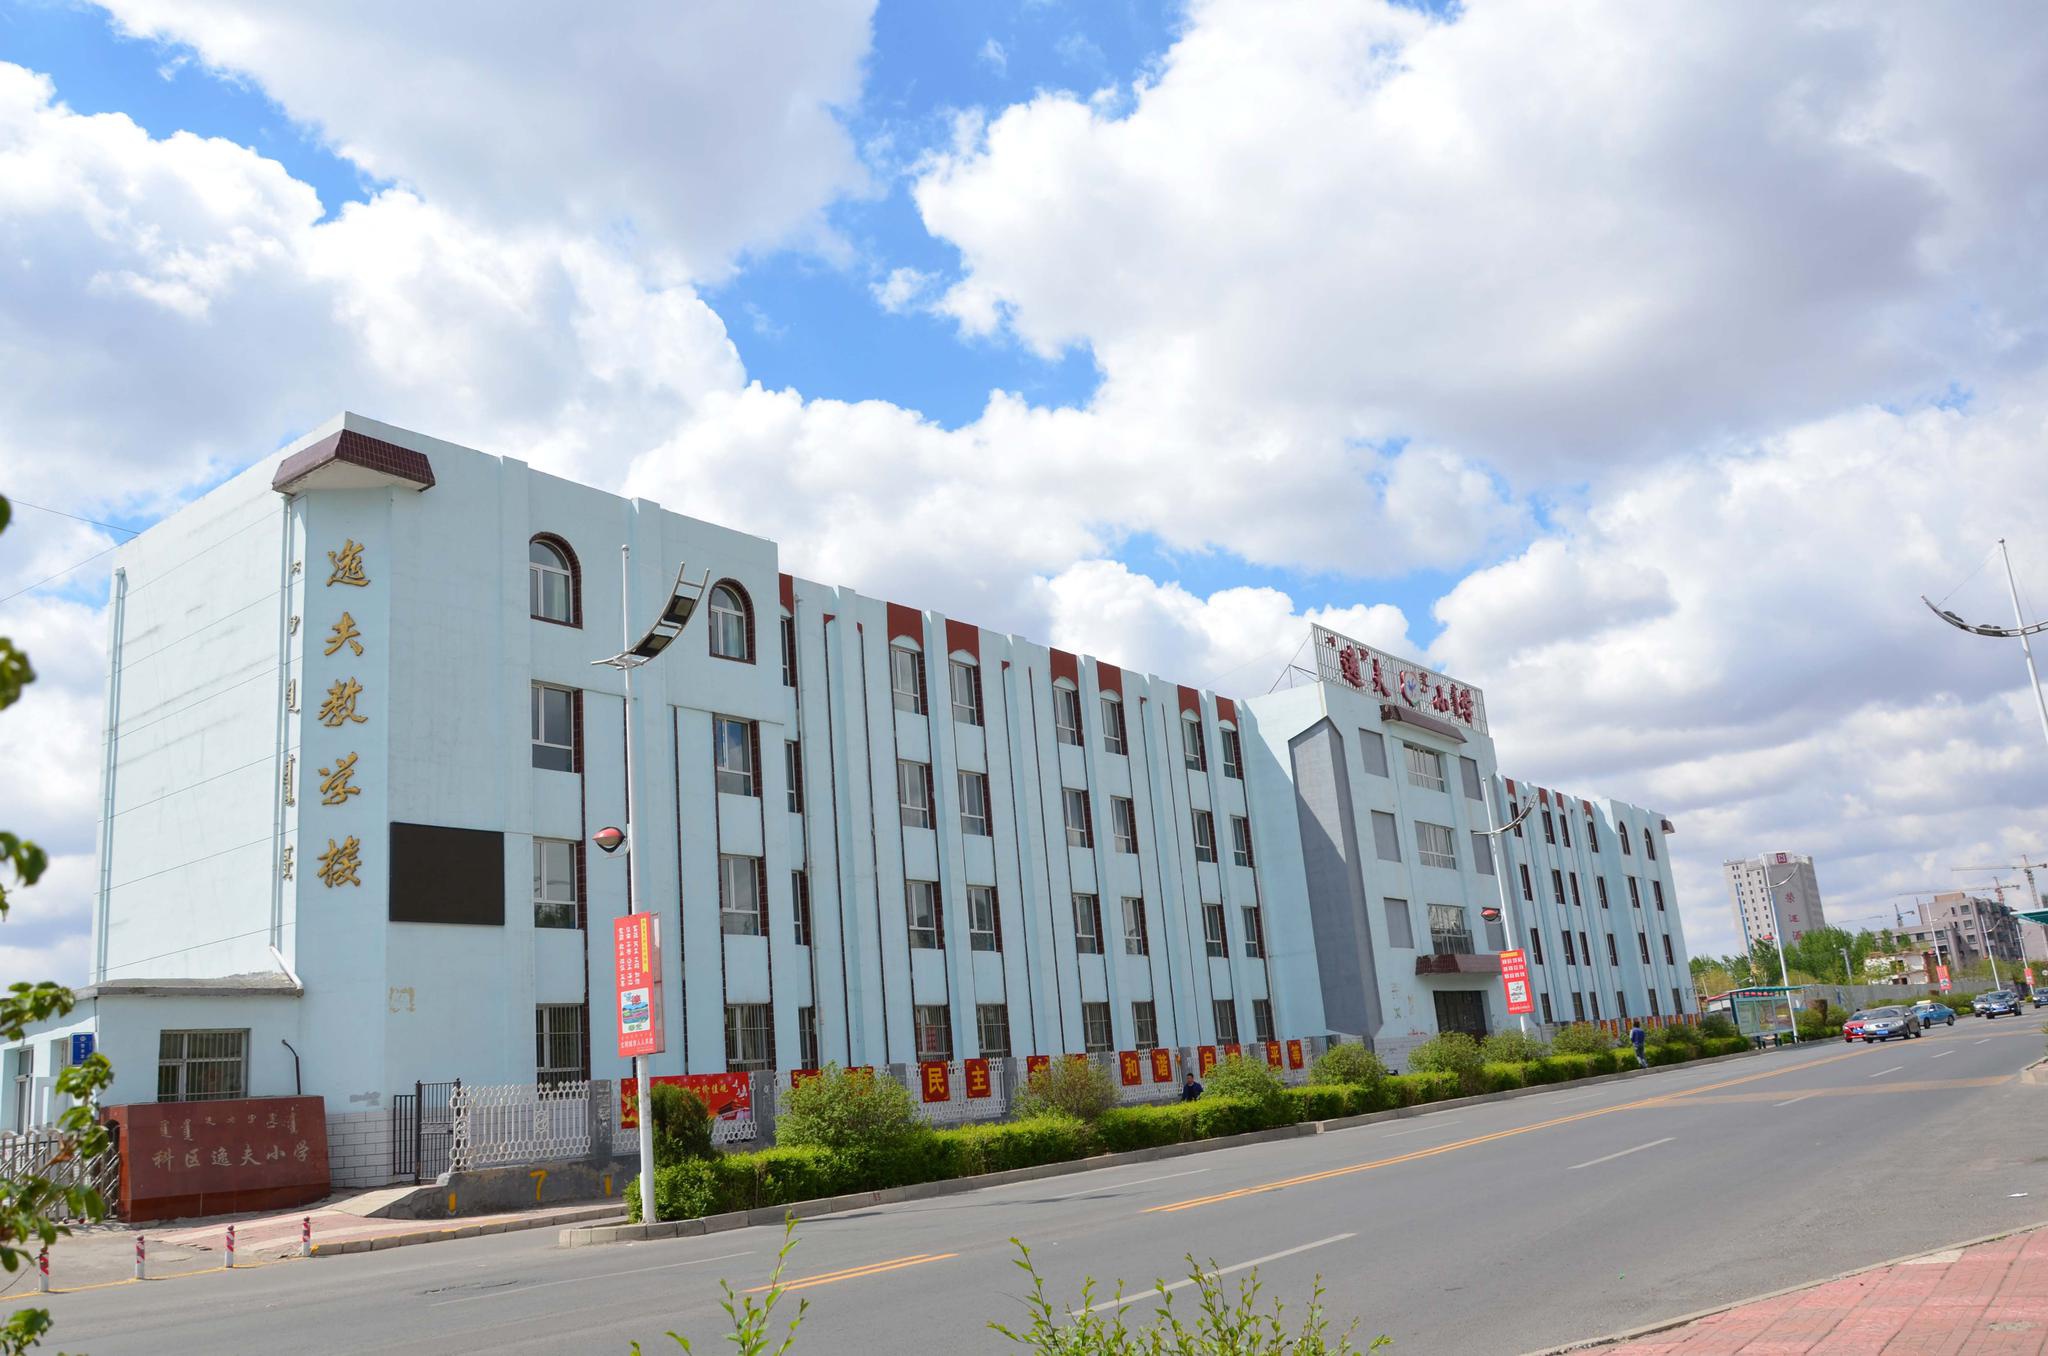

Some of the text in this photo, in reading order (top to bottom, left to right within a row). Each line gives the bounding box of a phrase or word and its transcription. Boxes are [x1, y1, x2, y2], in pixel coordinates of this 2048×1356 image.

[317, 538, 372, 888] 逸夫教学楼
[971, 1065, 987, 1090] 主
[1125, 1057, 1137, 1080] 和
[1156, 1054, 1168, 1077] 谐
[928, 1067, 945, 1094] 民
[152, 1139, 310, 1172] 科区逸夫小学
[530, 1169, 547, 1200] 7
